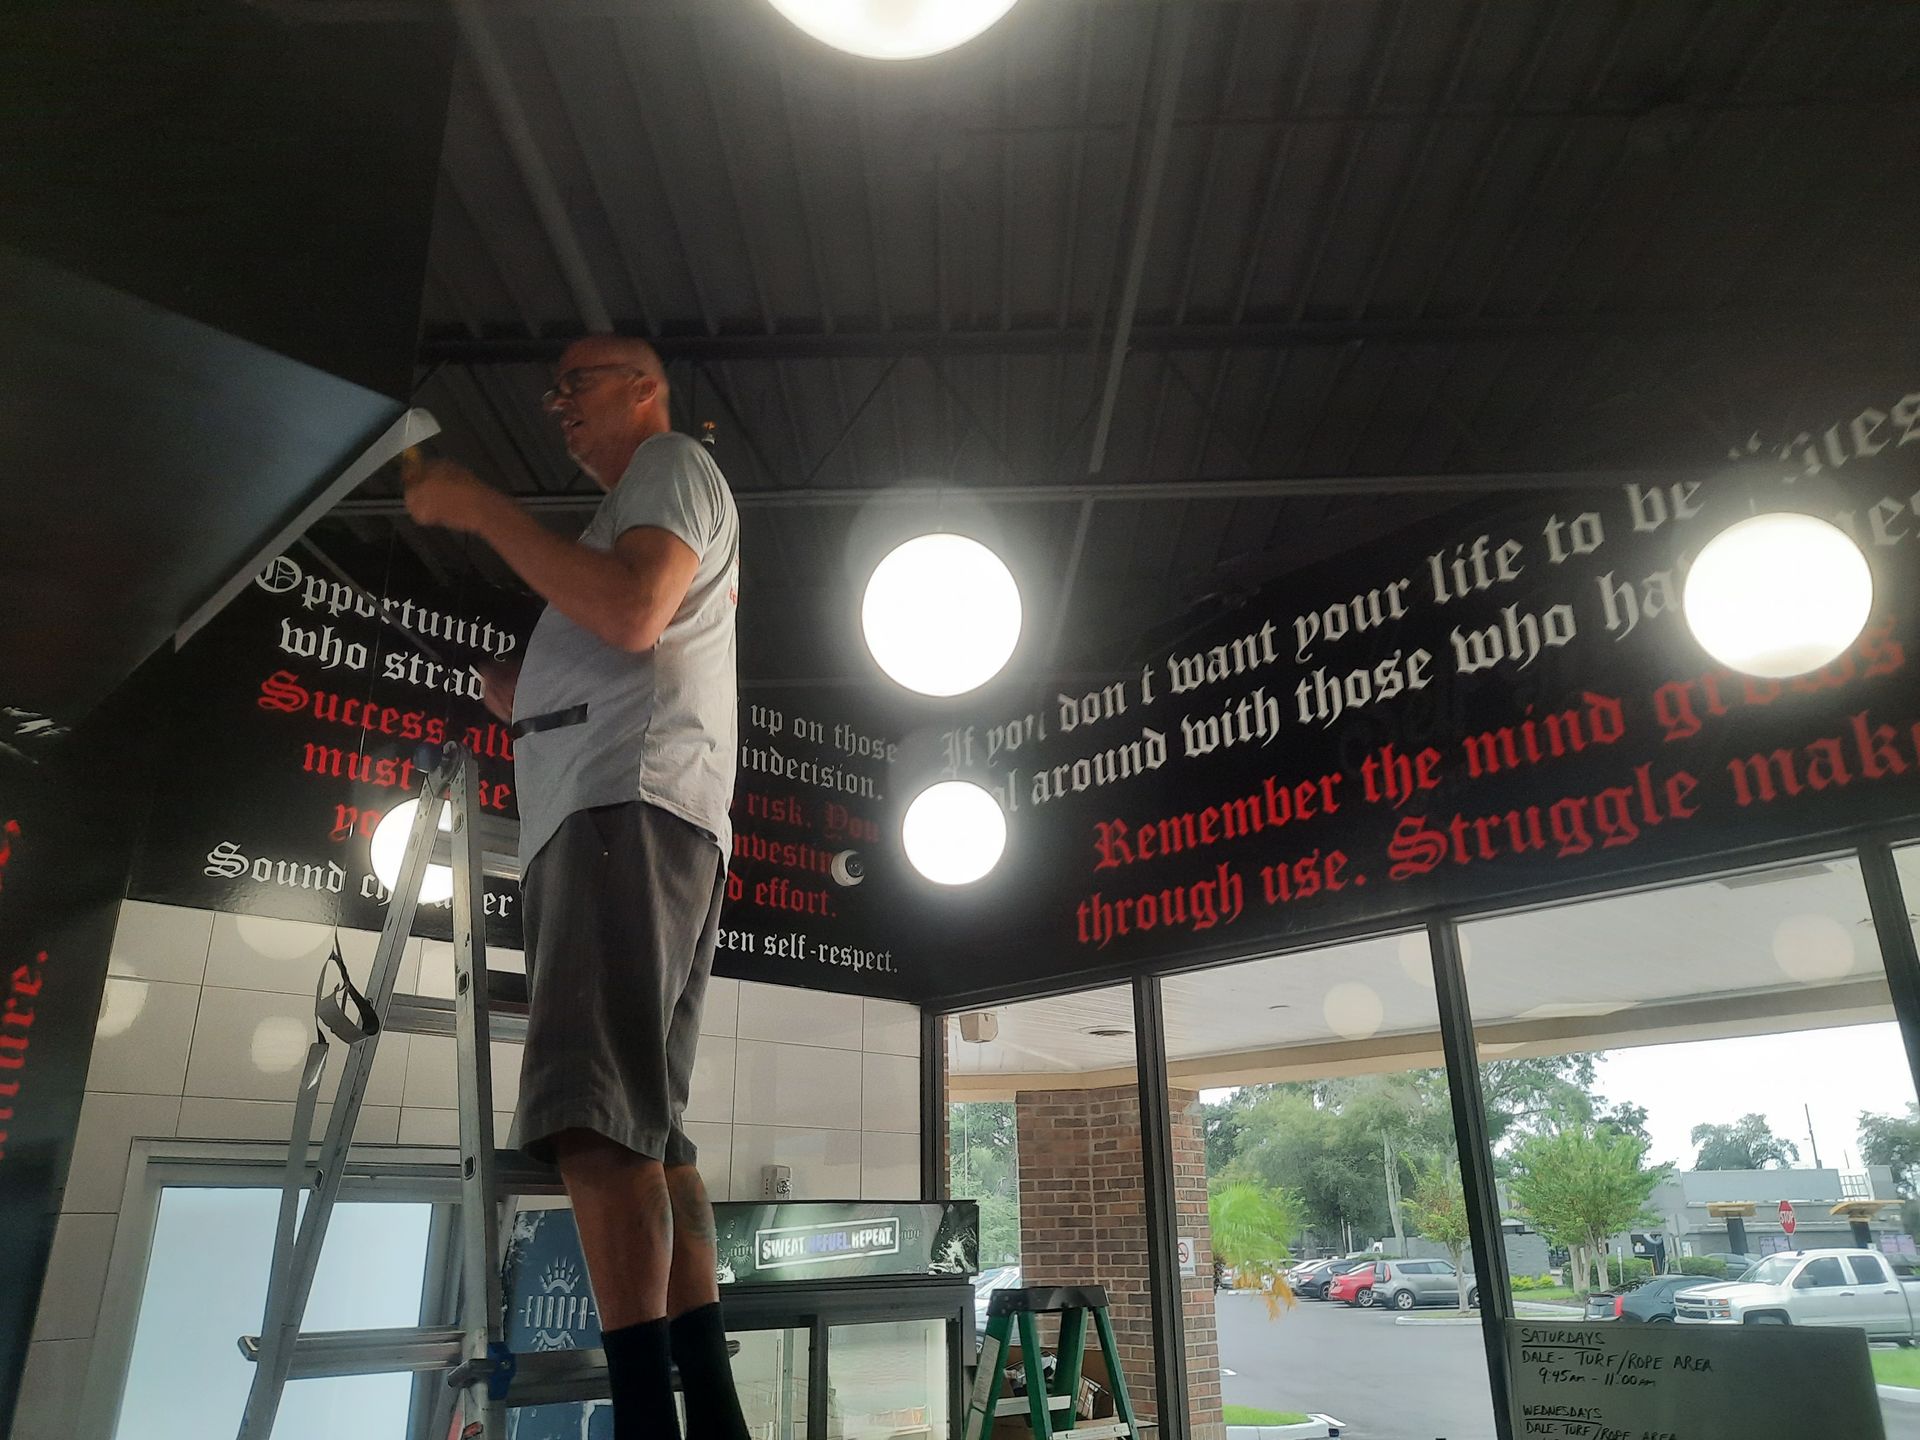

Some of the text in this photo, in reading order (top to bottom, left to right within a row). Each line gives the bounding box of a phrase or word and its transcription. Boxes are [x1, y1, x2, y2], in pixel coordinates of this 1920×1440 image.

[1167, 619, 1279, 696] want
[1291, 576, 1411, 663] your
[1427, 534, 1525, 606] life
[1542, 511, 1604, 565] to
[255, 556, 899, 764] Opportunity up on those
[258, 669, 447, 744] Success
[279, 617, 367, 670] who
[742, 738, 884, 800] indecision.
[1031, 727, 1169, 806] around
[1180, 686, 1281, 749] with
[1294, 646, 1434, 730] those
[1450, 602, 1578, 672] who
[303, 742, 415, 791] must
[1094, 771, 1343, 873] Remember
[1361, 742, 1442, 809] the
[1462, 691, 1627, 780] mind
[1076, 710, 1920, 950] through use. Struggle mak
[204, 841, 345, 896] Sound
[764, 934, 898, 973] self-respect.
[755, 876, 837, 918] effort.
[1780, 1210, 1793, 1224] STOP
[525, 1295, 589, 1330] EUROPA
[1521, 1328, 1605, 1345] SATURDAYS
[1673, 1355, 1713, 1372] AREA
[1523, 1404, 1603, 1419] WEDNESDAYS
